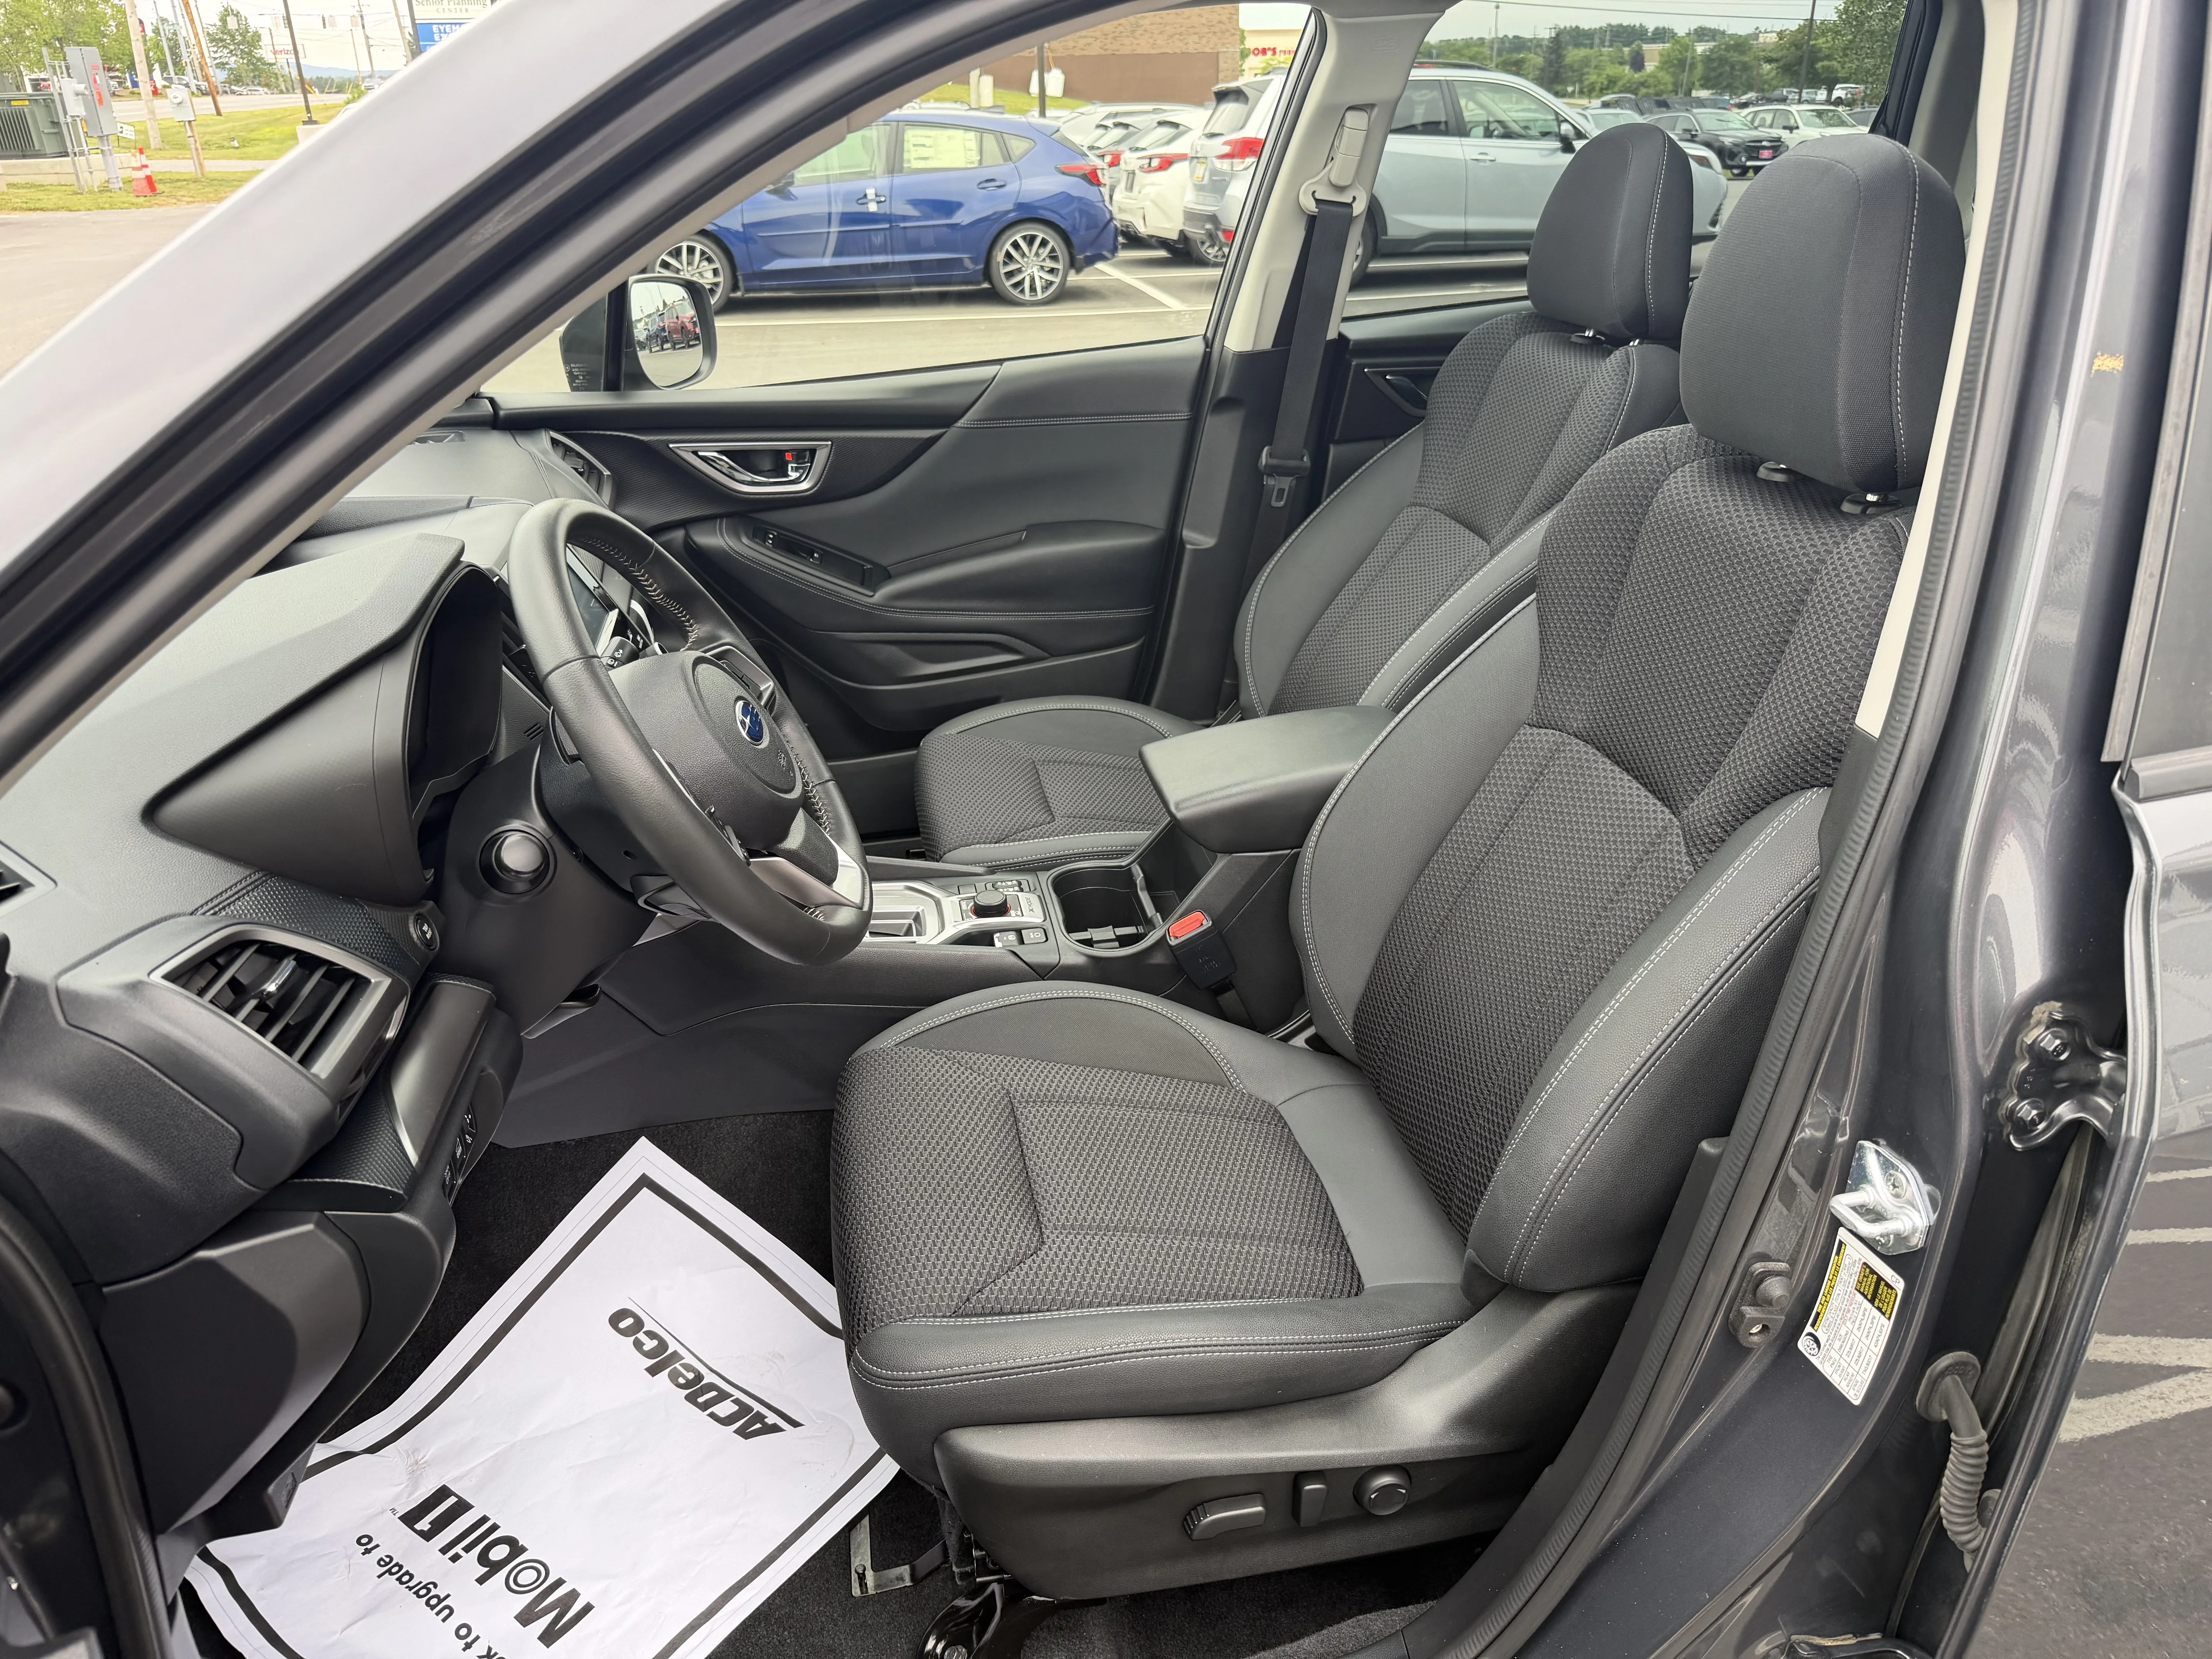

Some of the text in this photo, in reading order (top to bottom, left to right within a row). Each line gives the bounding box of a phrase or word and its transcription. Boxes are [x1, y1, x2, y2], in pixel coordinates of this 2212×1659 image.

[433, 24, 461, 33] EYEM
[1247, 47, 1276, 56] OB'S
[1891, 1275, 1900, 1284] CP
[1837, 1329, 1849, 1353] DIMENSIONS
[608, 1308, 787, 1441] ACDelco
[1834, 1361, 1842, 1375] FRONT
[1838, 1365, 1846, 1379] AVANT
[1851, 1378, 1859, 1391] SPARE
[356, 1534, 381, 1556] to
[376, 1554, 455, 1623] upgrade
[438, 1514, 595, 1649] Mobil
[454, 1623, 481, 1652] to
